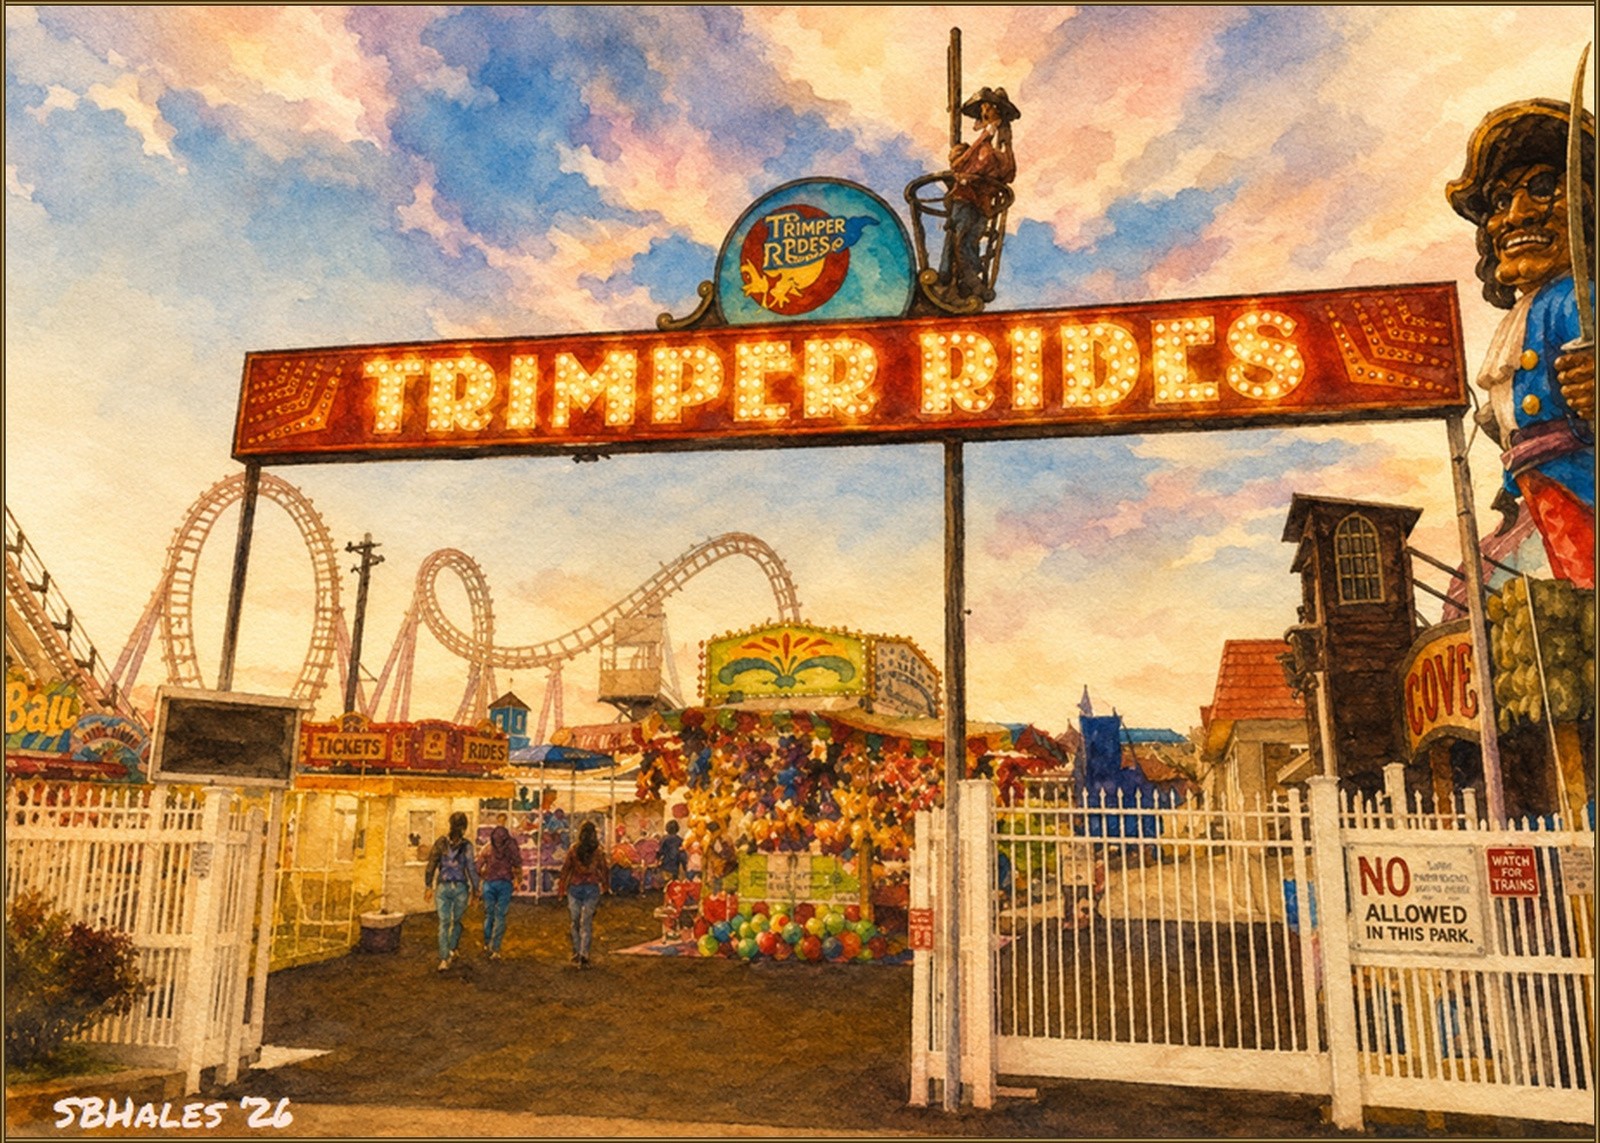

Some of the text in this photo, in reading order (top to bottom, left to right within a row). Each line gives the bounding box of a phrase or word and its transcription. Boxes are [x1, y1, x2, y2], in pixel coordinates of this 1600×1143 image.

[765, 212, 846, 239] TRIMPER
[362, 309, 1305, 434] TRIMPER RIDES
[1406, 643, 1478, 735] COVE
[6, 681, 78, 738] Ball
[317, 736, 382, 756] TICKETS
[467, 741, 506, 760] RIDES
[1491, 855, 1530, 867] WATCH
[1358, 856, 1411, 898] NO
[1501, 867, 1523, 878] FOR
[1491, 878, 1536, 892] TRAINS
[1365, 903, 1468, 925] ALLOWED
[1366, 925, 1475, 944] IN THIS PARK.
